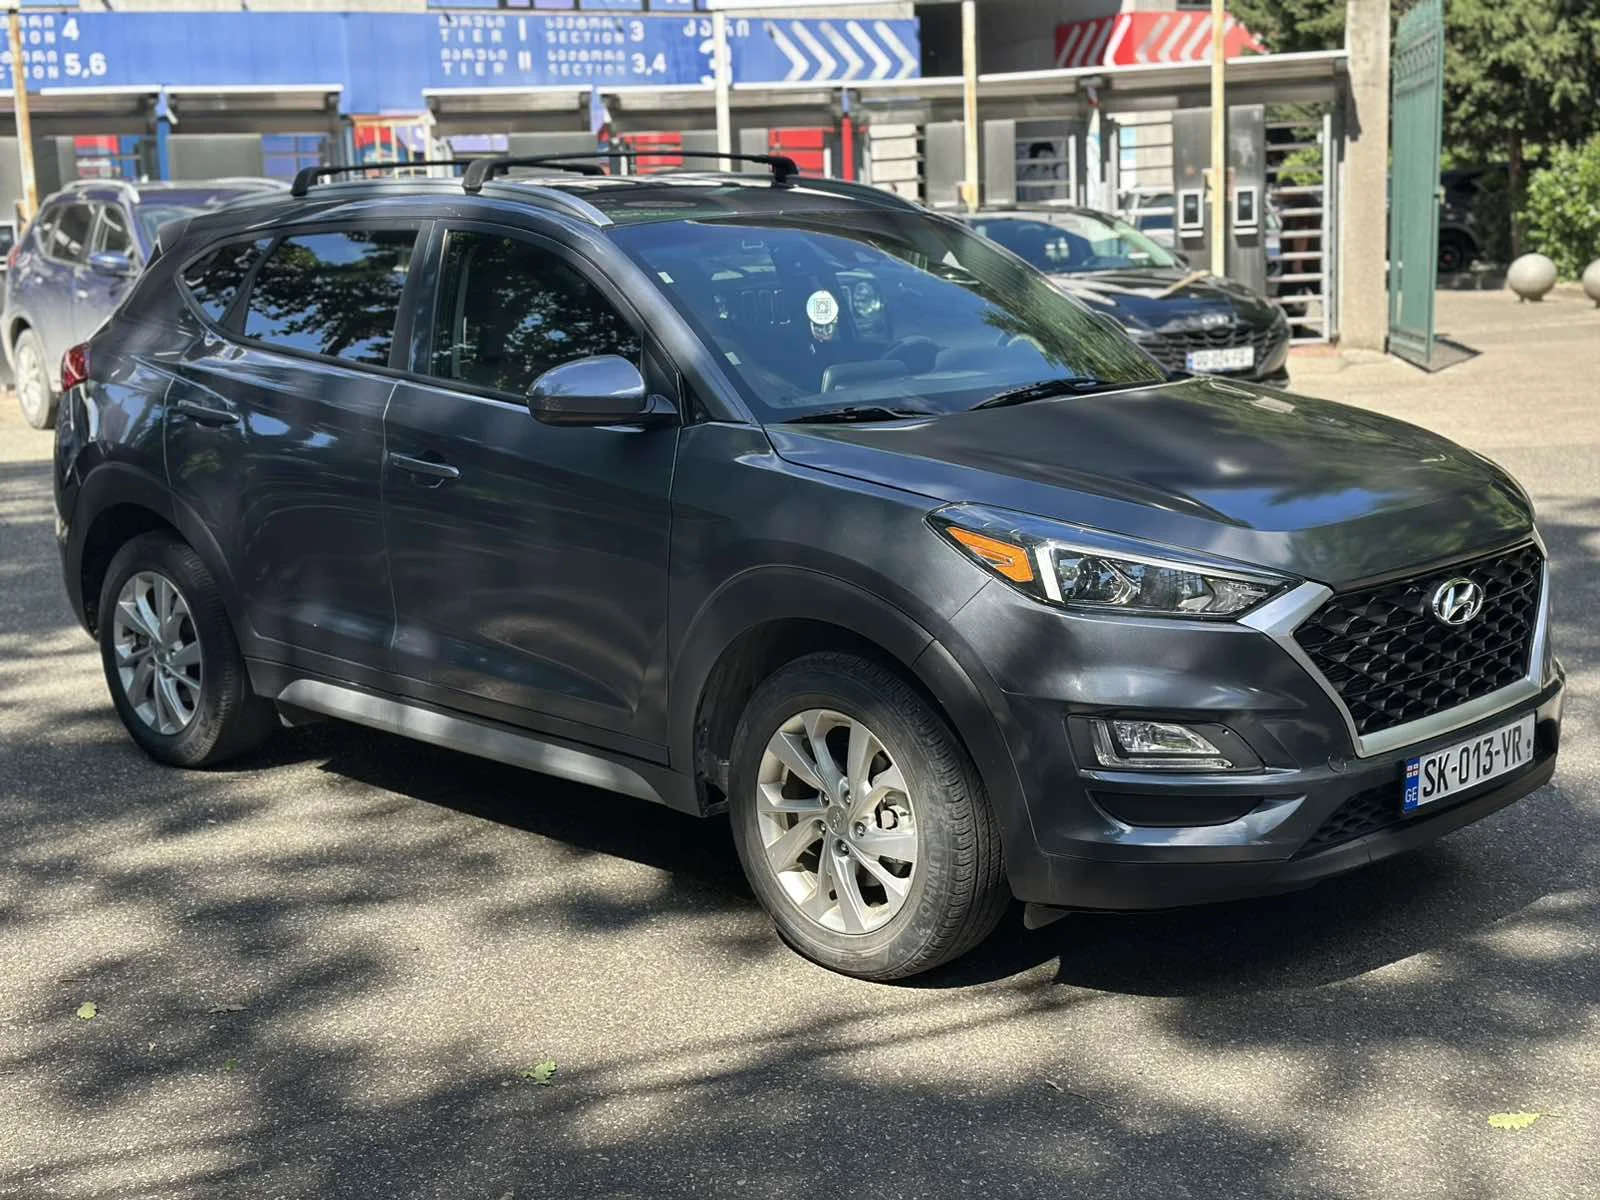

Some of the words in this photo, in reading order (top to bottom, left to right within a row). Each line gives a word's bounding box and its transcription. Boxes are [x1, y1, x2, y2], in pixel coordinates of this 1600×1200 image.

[62, 17, 80, 41] 4
[440, 28, 503, 43] TIER
[546, 30, 625, 44] SECTION
[629, 20, 645, 42] 3
[64, 52, 107, 79] 5,6
[442, 62, 504, 76] TIER
[548, 62, 626, 77] SECTION
[631, 52, 667, 76] 3,4
[1423, 725, 1521, 797] SK-013-YR
[1405, 786, 1417, 803] GE
